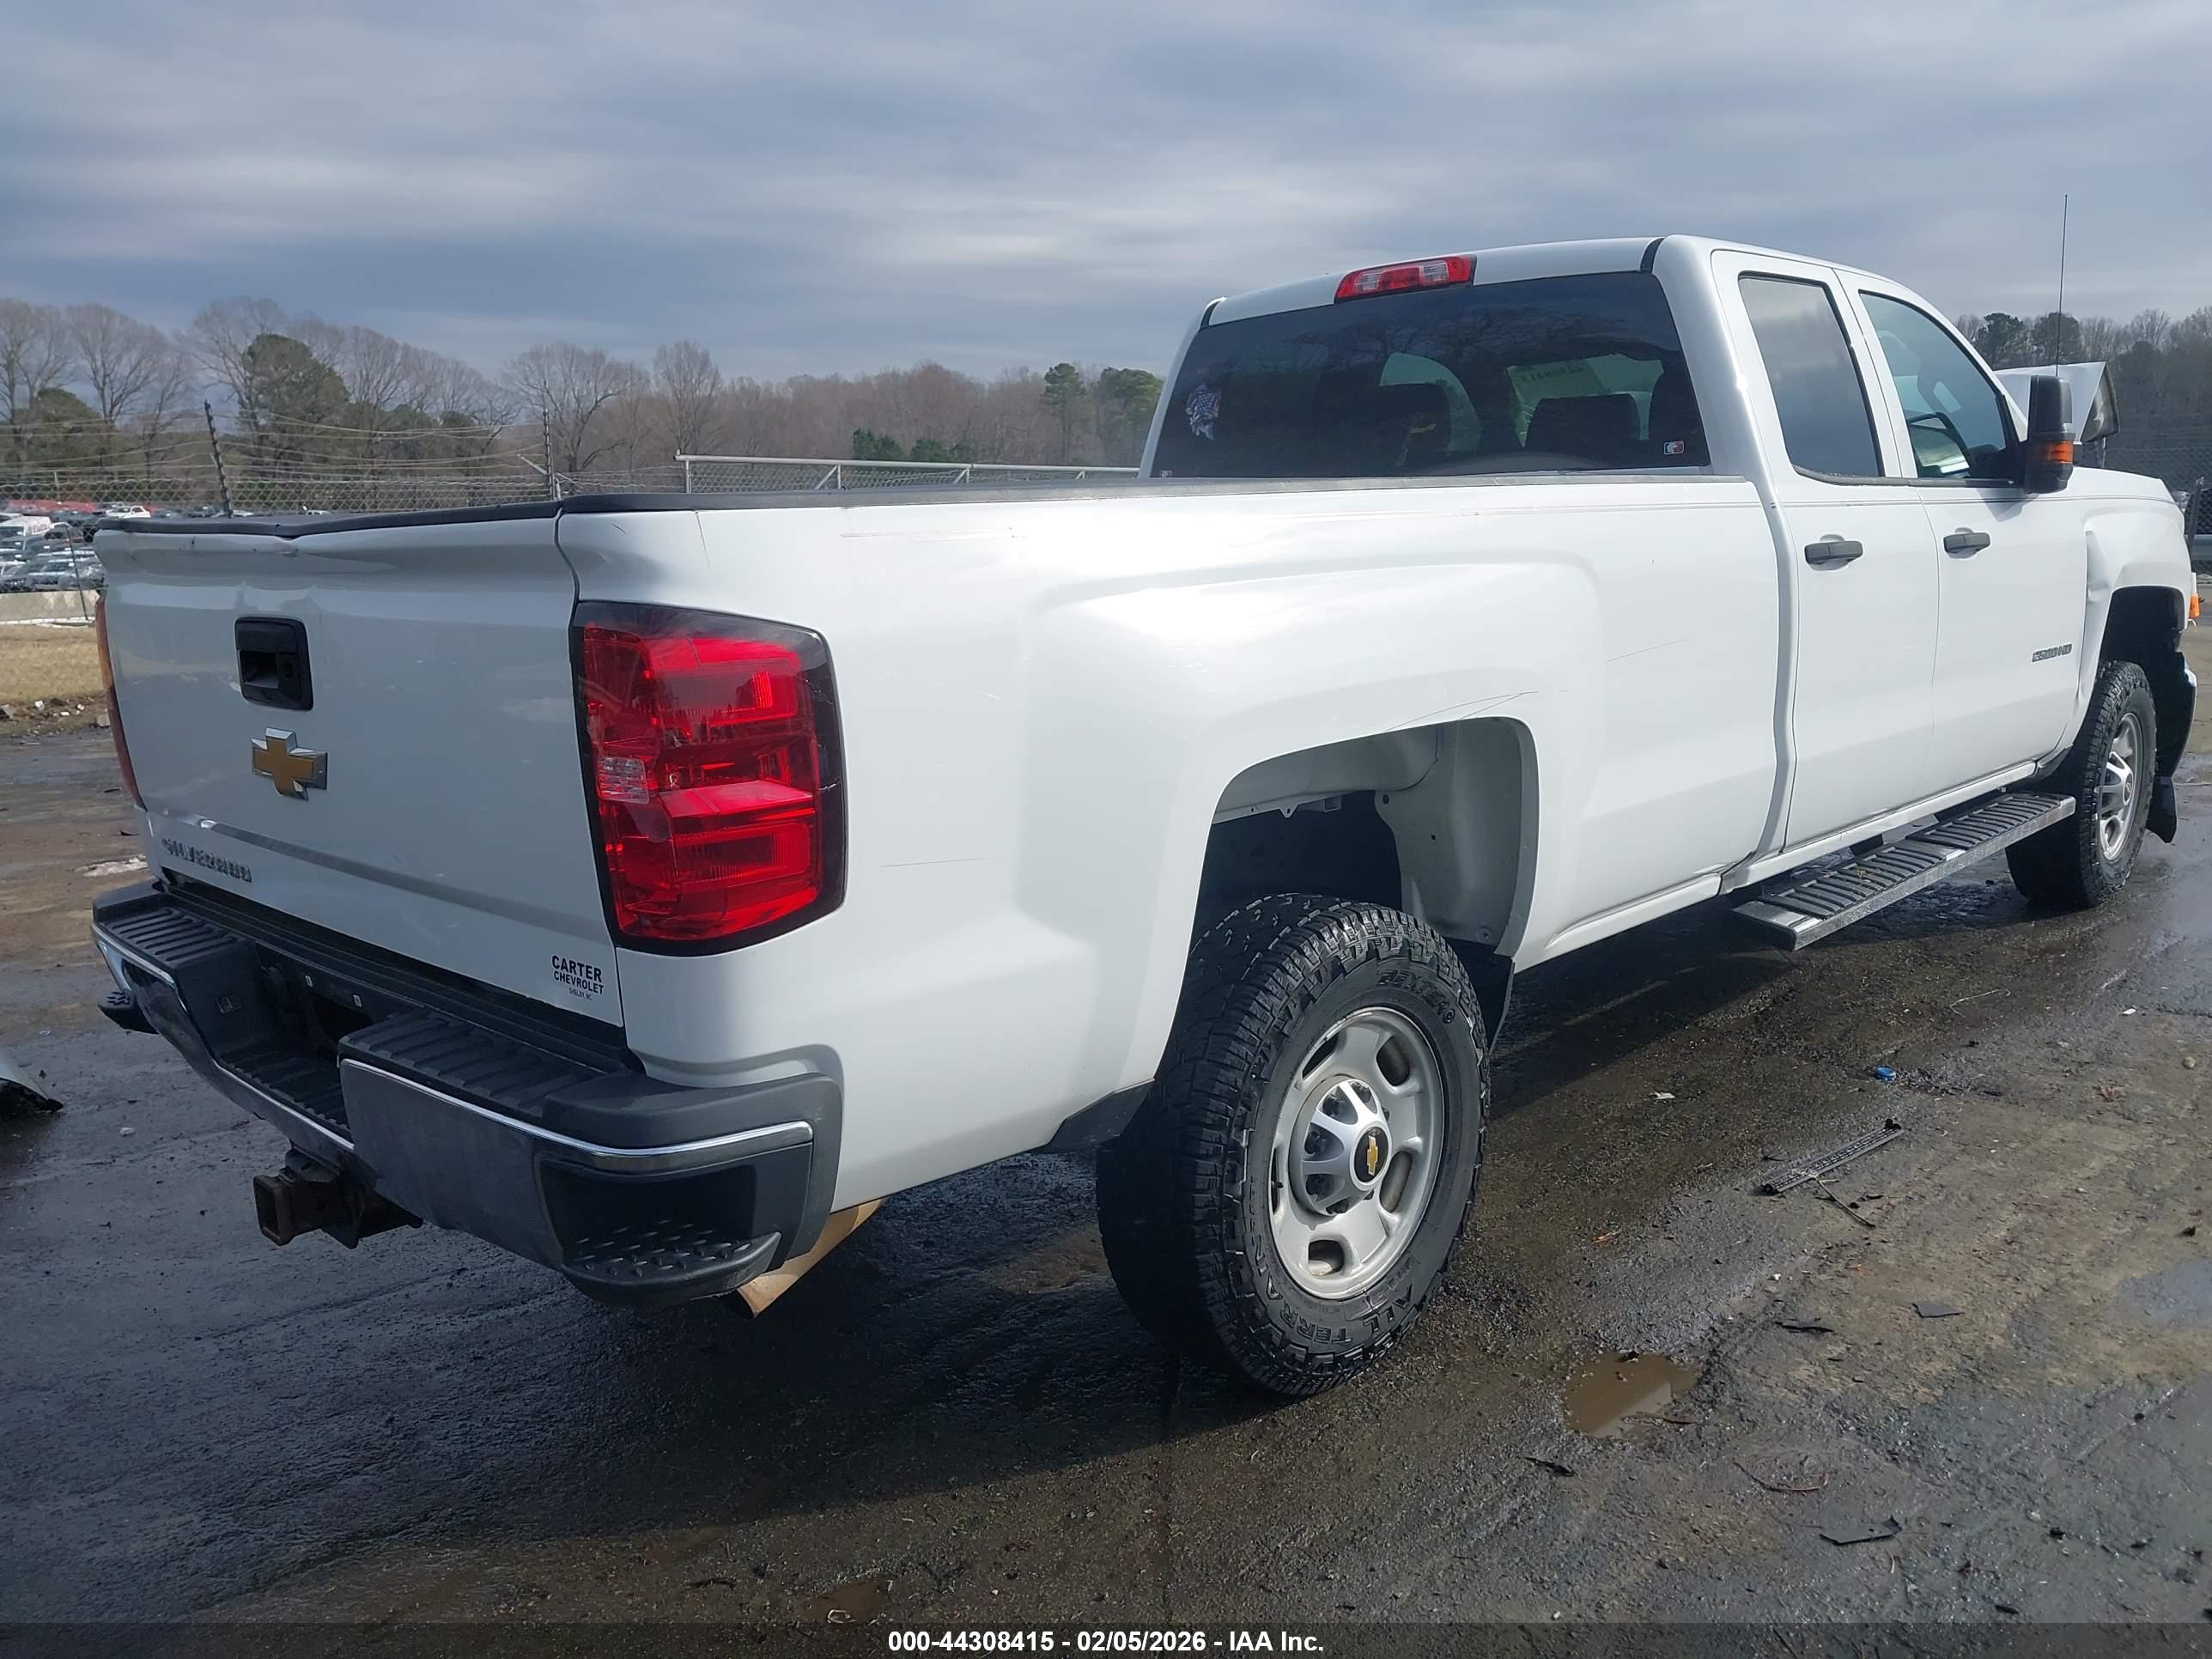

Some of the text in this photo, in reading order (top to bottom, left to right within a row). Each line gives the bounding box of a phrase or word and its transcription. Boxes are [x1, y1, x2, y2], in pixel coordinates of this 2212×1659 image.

[161, 837, 252, 884] SILVERADO
[551, 955, 603, 983] CARTER
[554, 970, 605, 994] CHEVROLET
[1251, 1234, 1352, 1344] TERRAIN
[1363, 1284, 1413, 1333] ALL
